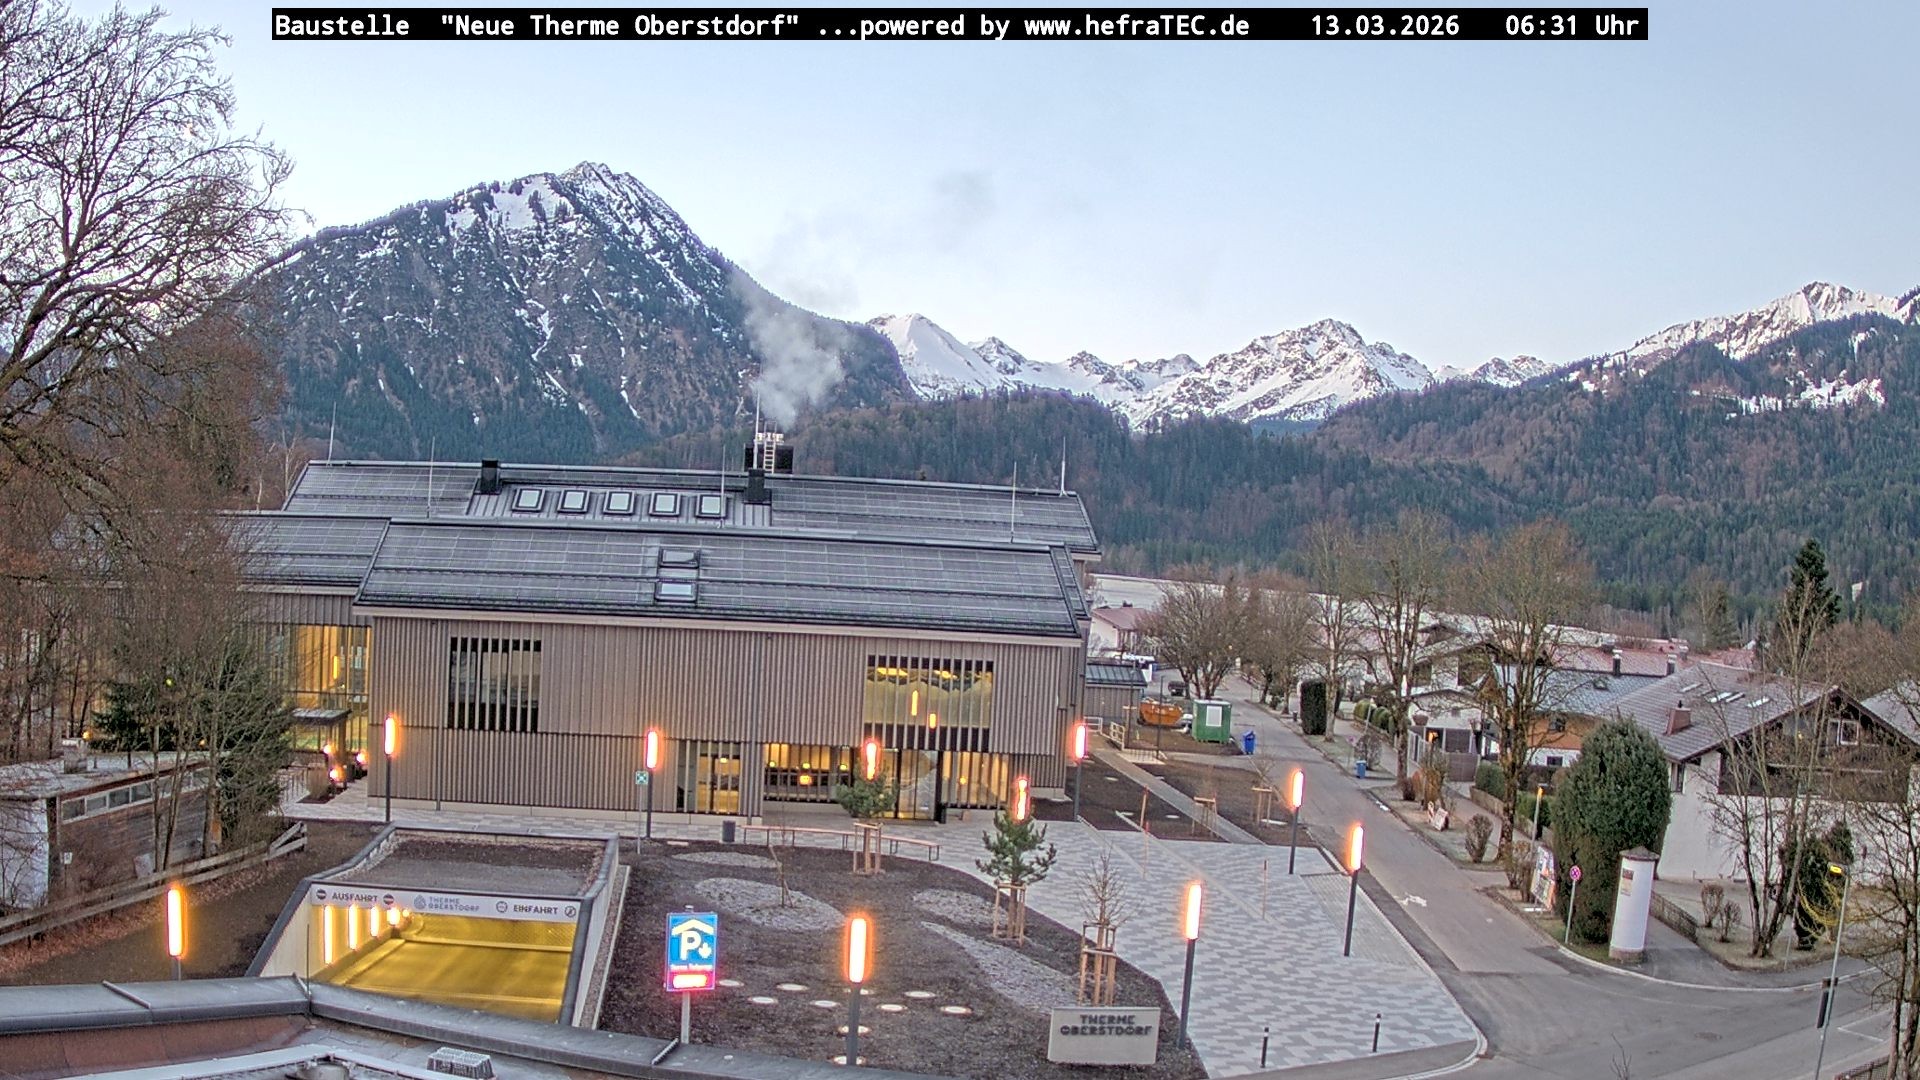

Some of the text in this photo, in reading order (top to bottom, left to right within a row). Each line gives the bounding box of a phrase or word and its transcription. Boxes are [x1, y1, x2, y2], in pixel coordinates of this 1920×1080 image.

[331, 891, 378, 903] AUSFAHRT
[429, 896, 460, 905] THERME
[513, 904, 558, 915] EINFAHRT
[680, 930, 702, 961] P
[1080, 1014, 1136, 1025] THERME
[1060, 1025, 1153, 1037] OBERSTDORF
